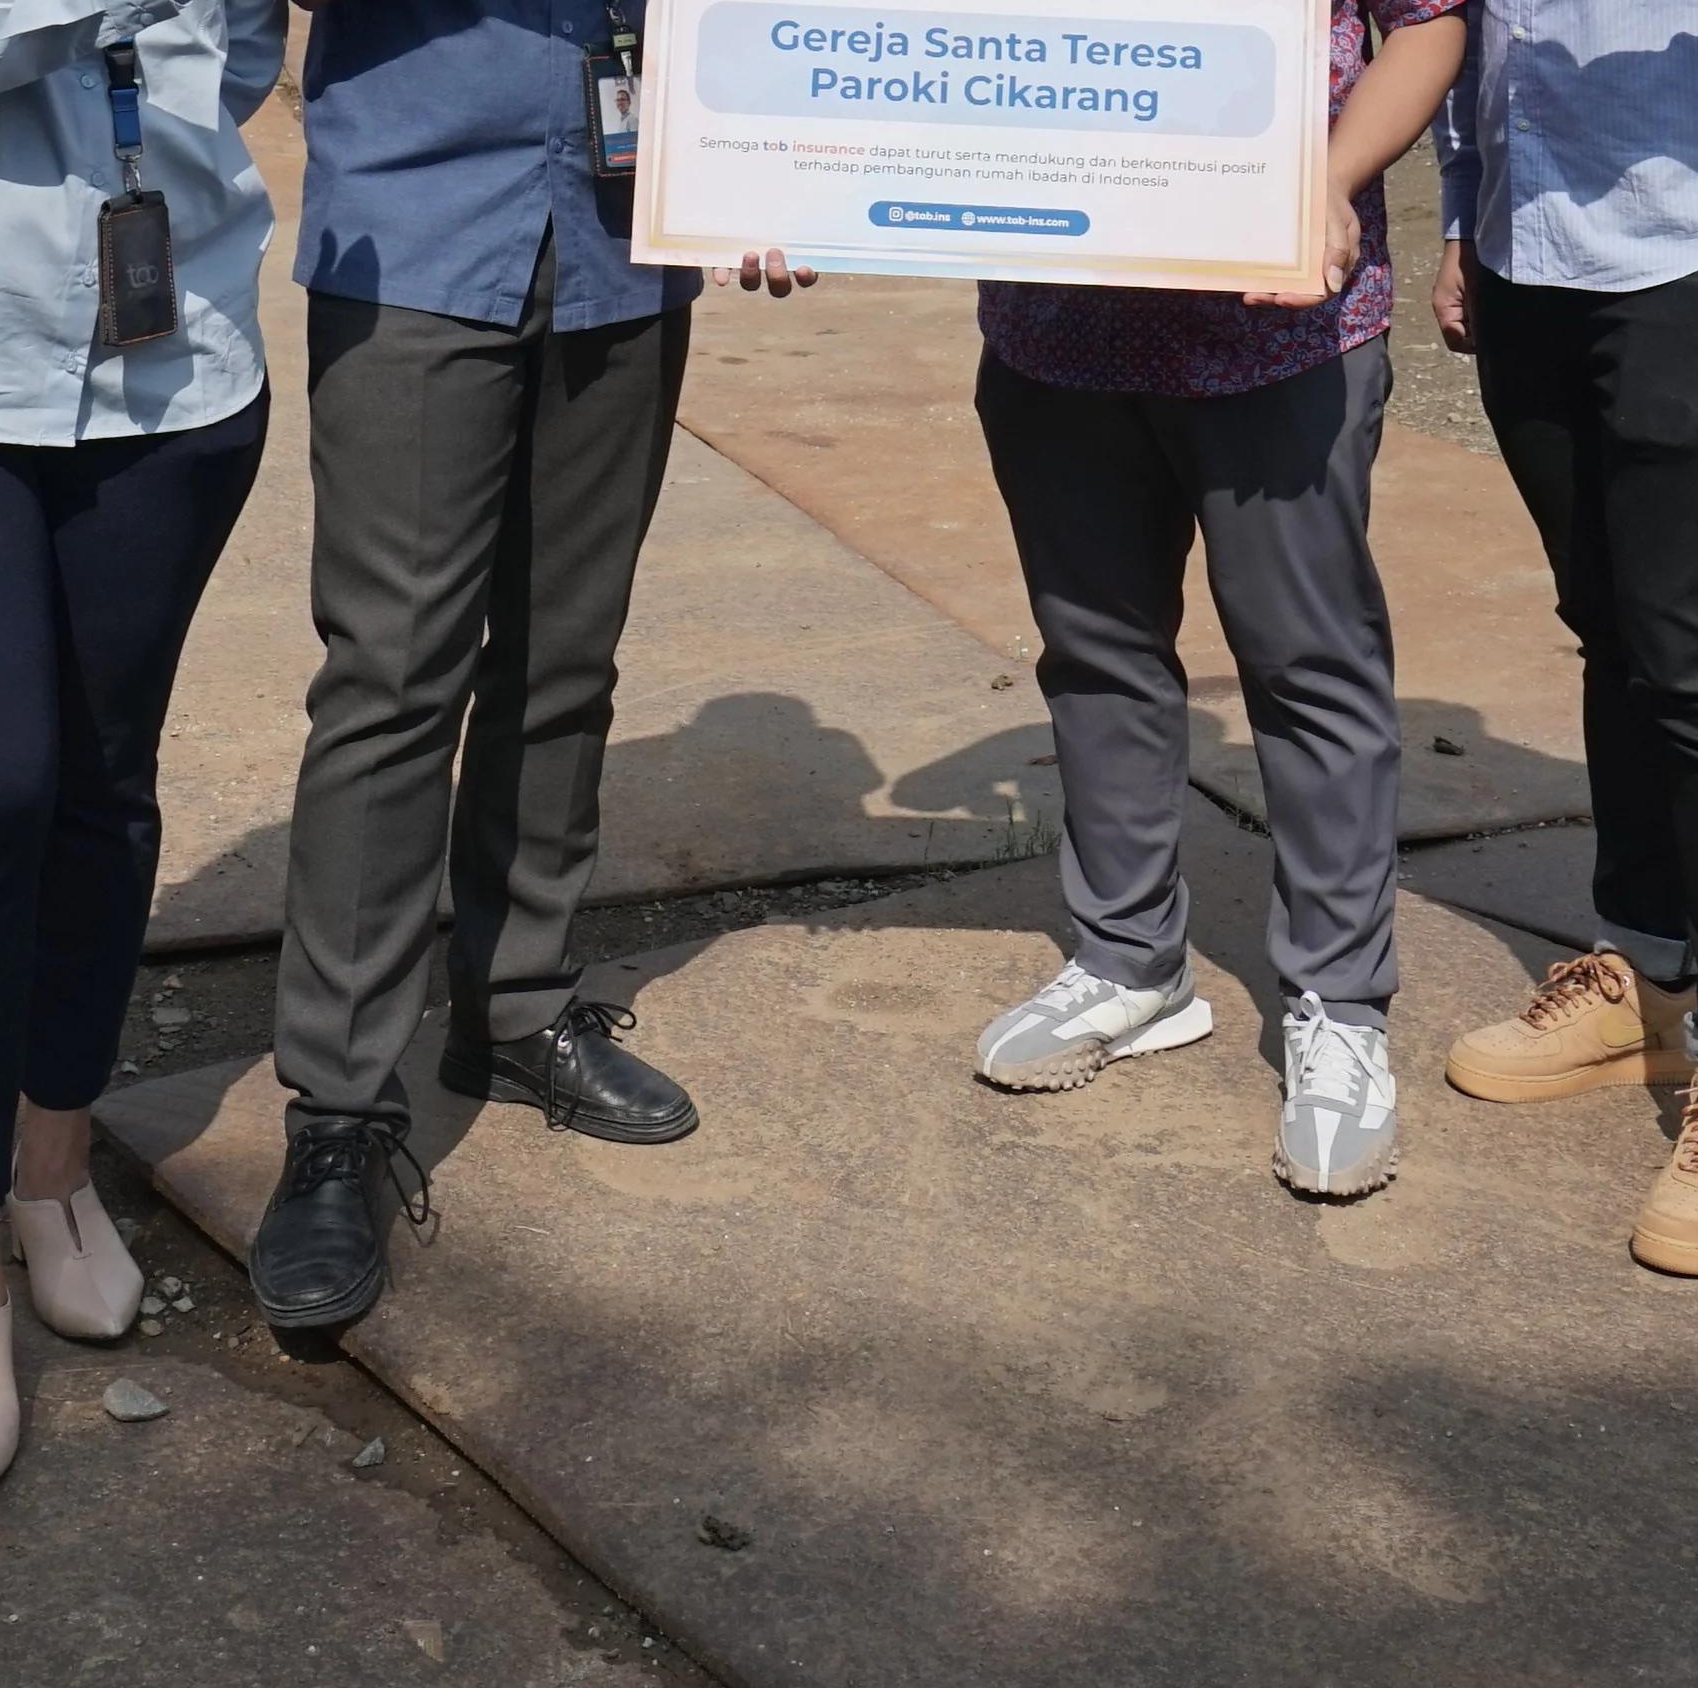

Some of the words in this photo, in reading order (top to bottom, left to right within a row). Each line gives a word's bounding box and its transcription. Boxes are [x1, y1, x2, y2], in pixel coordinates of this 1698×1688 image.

[771, 20, 908, 61] Gereja
[925, 28, 1046, 62] Santa
[1062, 34, 1201, 69] Teresa
[812, 68, 949, 103] Paroki
[965, 73, 1158, 121] Cikarang
[700, 137, 758, 152] Semoga
[763, 140, 788, 152] tob
[792, 140, 865, 156] insurance
[869, 145, 912, 160] dapat
[915, 148, 952, 161] turut
[955, 150, 991, 162] serta
[994, 152, 1085, 169] mendukung
[1089, 156, 1116, 168] dan
[1122, 157, 1217, 172] berkontribusi
[1222, 162, 1266, 175] positif
[794, 160, 859, 174] terhadap
[864, 164, 971, 179] pembangunan
[976, 169, 1023, 180] rumah
[1028, 170, 1078, 183] ibadah
[1082, 173, 1095, 185] di
[1099, 174, 1169, 188] Indonesia
[976, 214, 1070, 228] www.tob-ins.com
